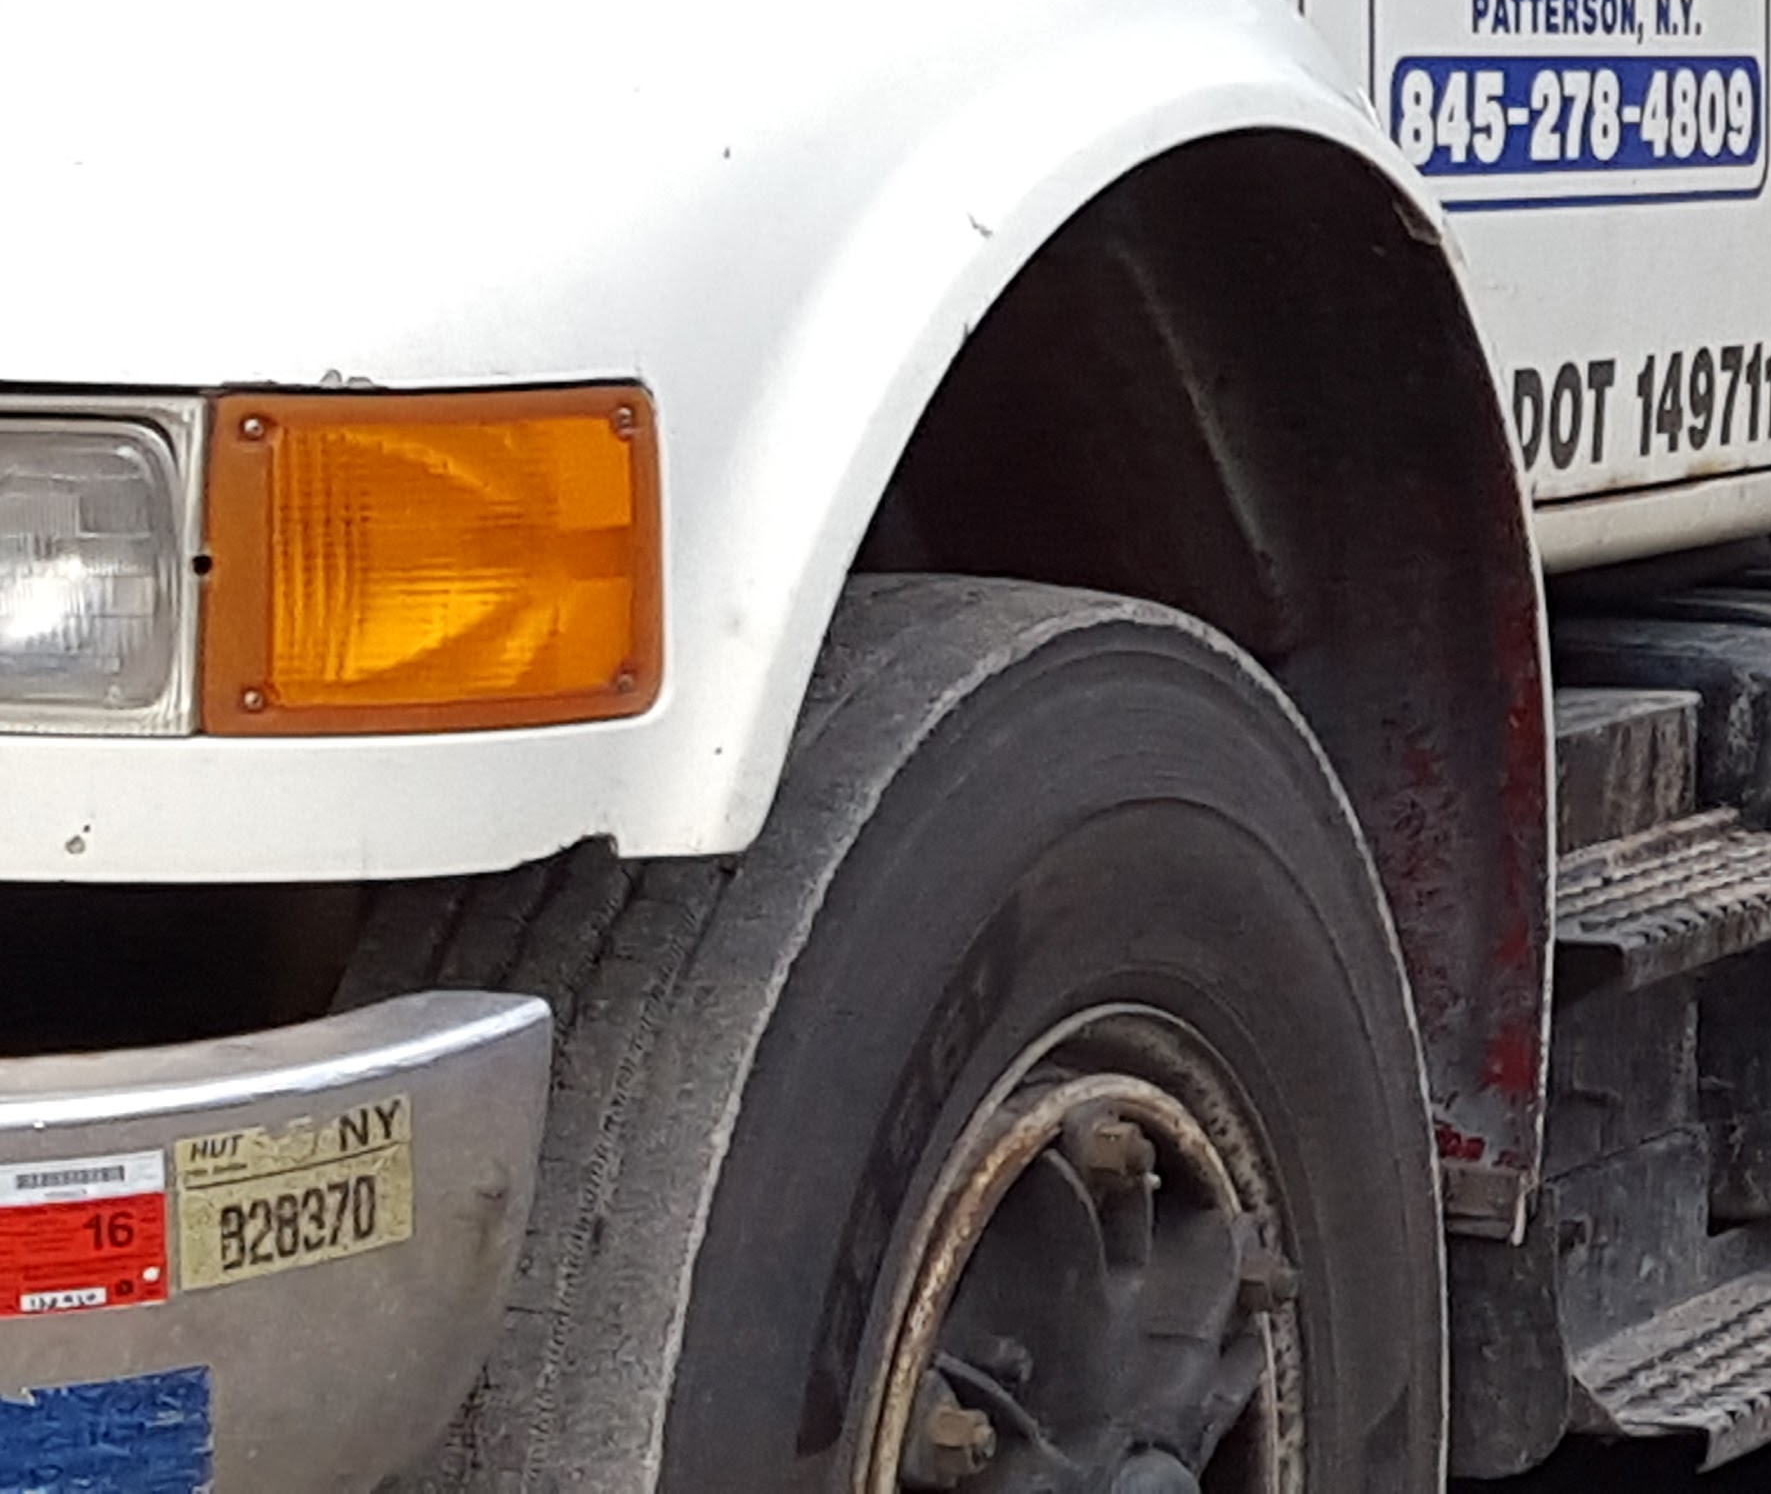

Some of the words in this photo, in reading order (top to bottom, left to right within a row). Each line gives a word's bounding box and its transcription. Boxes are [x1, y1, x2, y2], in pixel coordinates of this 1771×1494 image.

[1401, 68, 1754, 167] 845-278-4809
[1513, 358, 1616, 472] DOT
[190, 1134, 243, 1162] HUT
[339, 1098, 401, 1152] NY
[82, 1211, 135, 1251] 16
[220, 1175, 377, 1271] B28370
